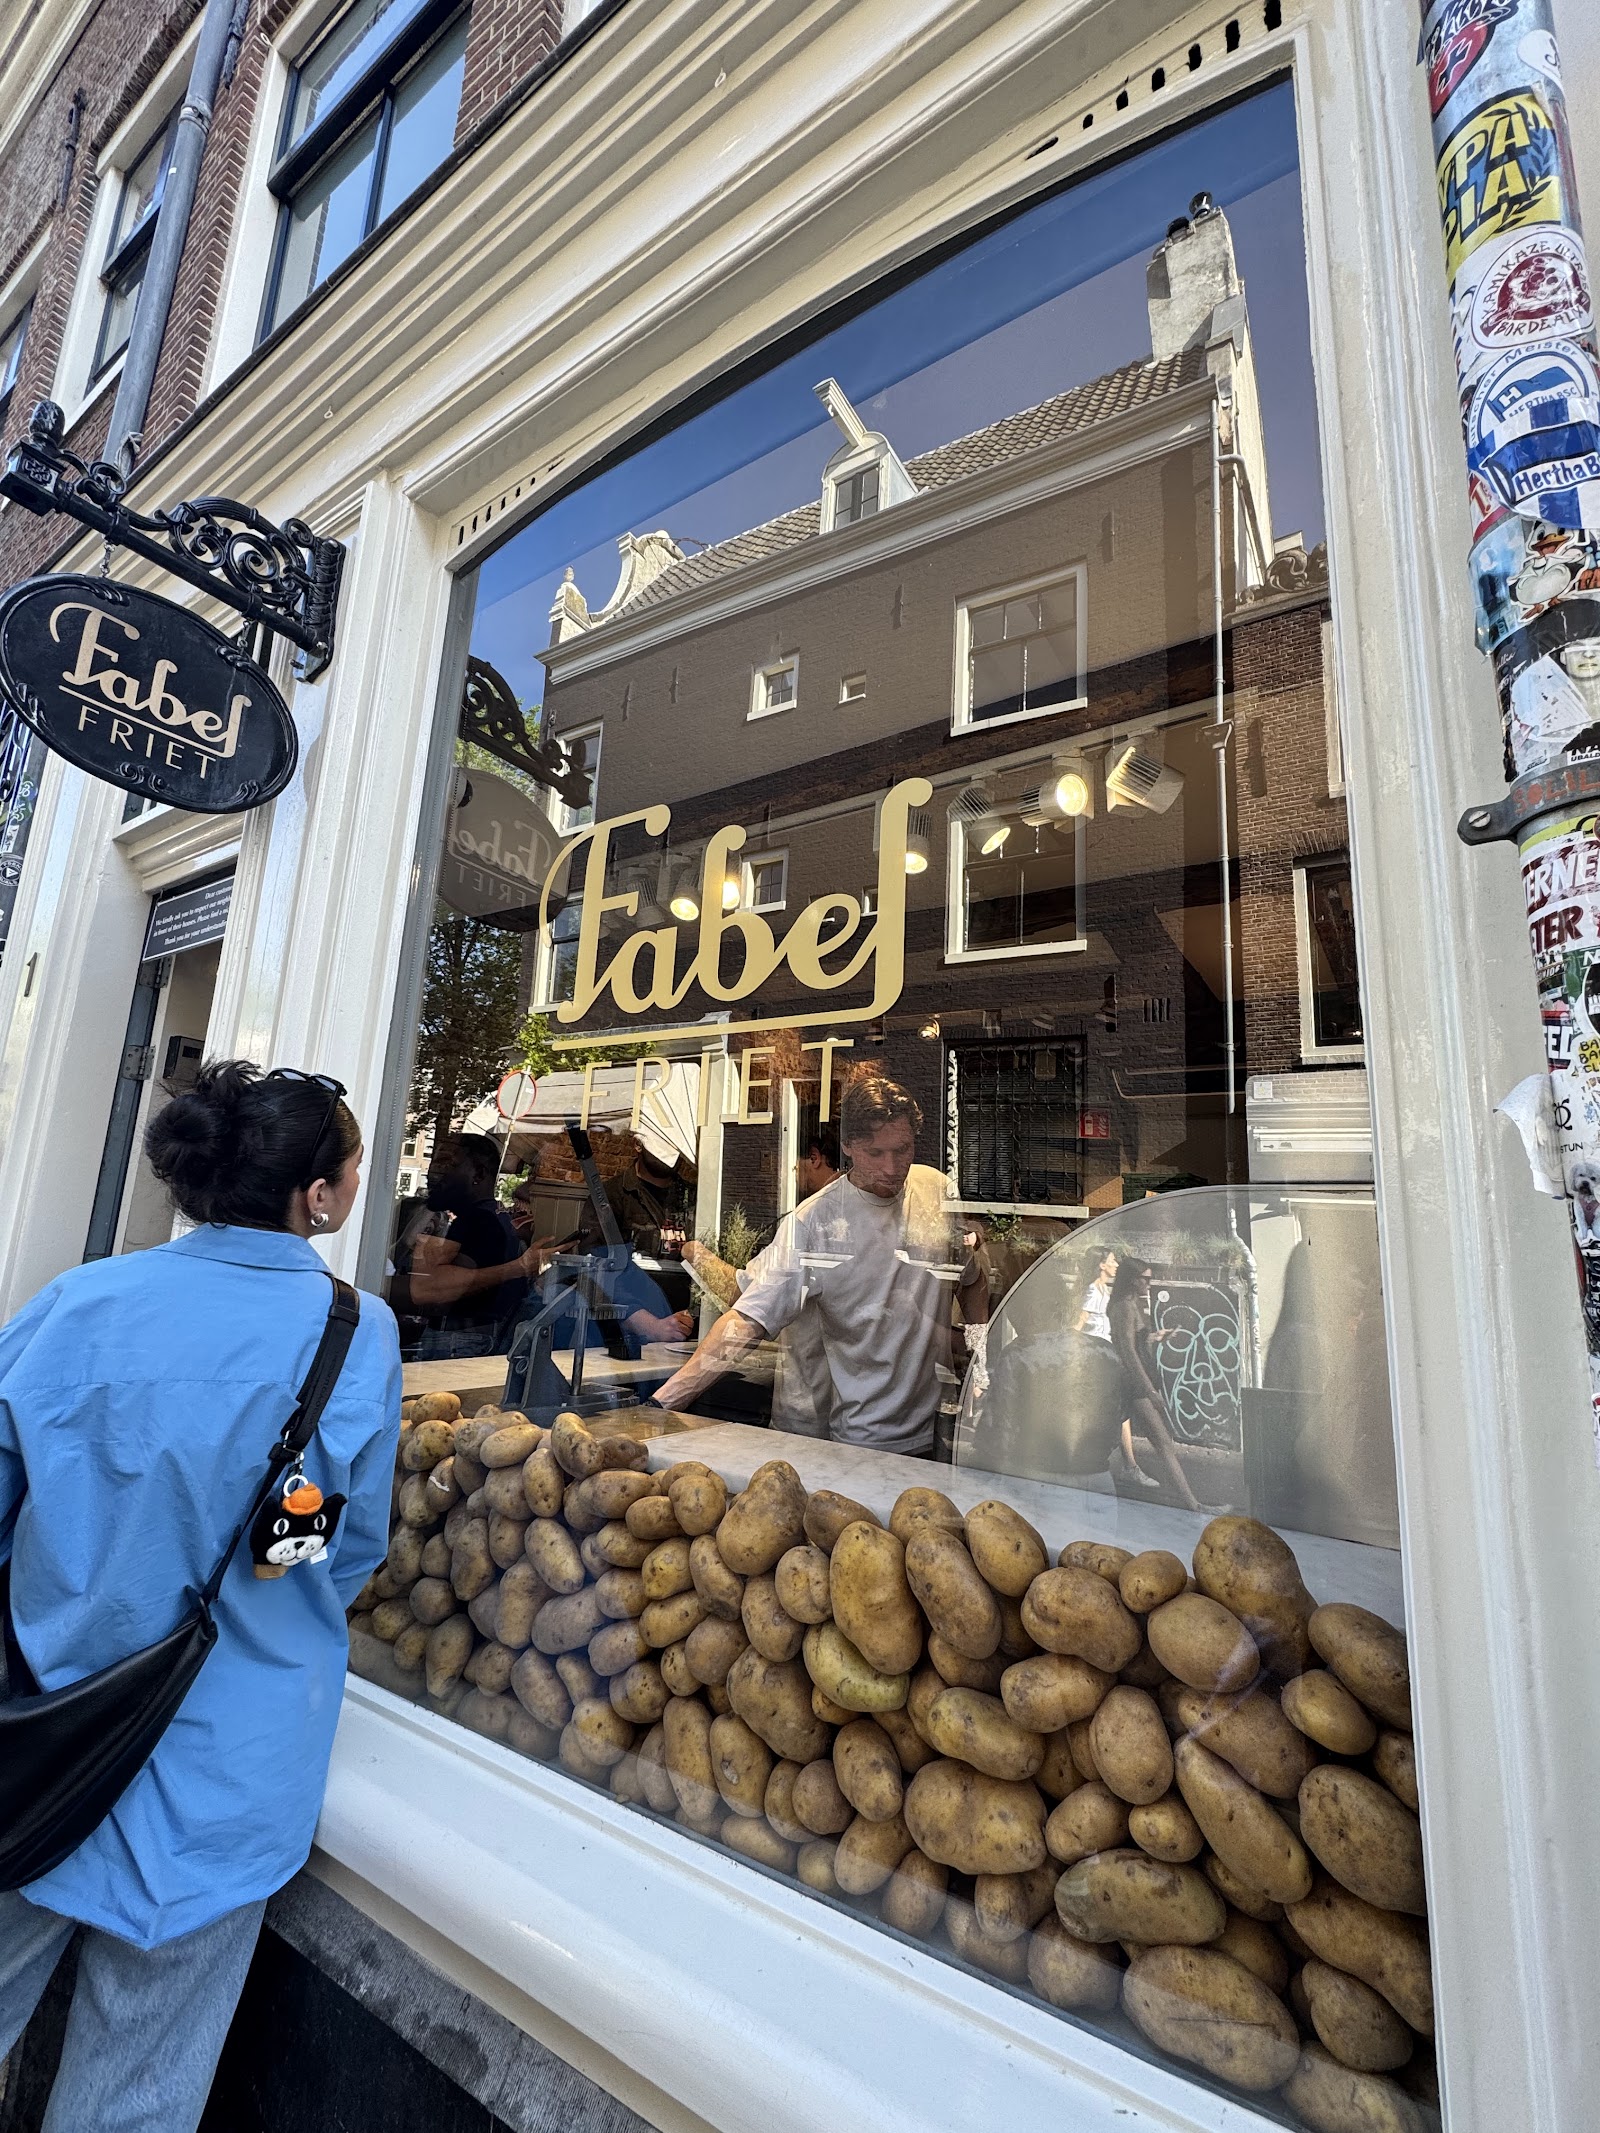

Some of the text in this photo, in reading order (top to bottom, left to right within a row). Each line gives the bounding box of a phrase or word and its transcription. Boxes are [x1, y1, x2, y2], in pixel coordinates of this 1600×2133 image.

[1481, 240, 1550, 319] KAMIKAZE
[1504, 341, 1578, 364] Meister
[1515, 461, 1588, 496] Hertha
[50, 602, 252, 758] Fabel
[78, 704, 216, 779] FRIET
[539, 777, 933, 1027] Fabel
[25, 952, 38, 997] 1
[580, 1039, 855, 1131] FRIET
